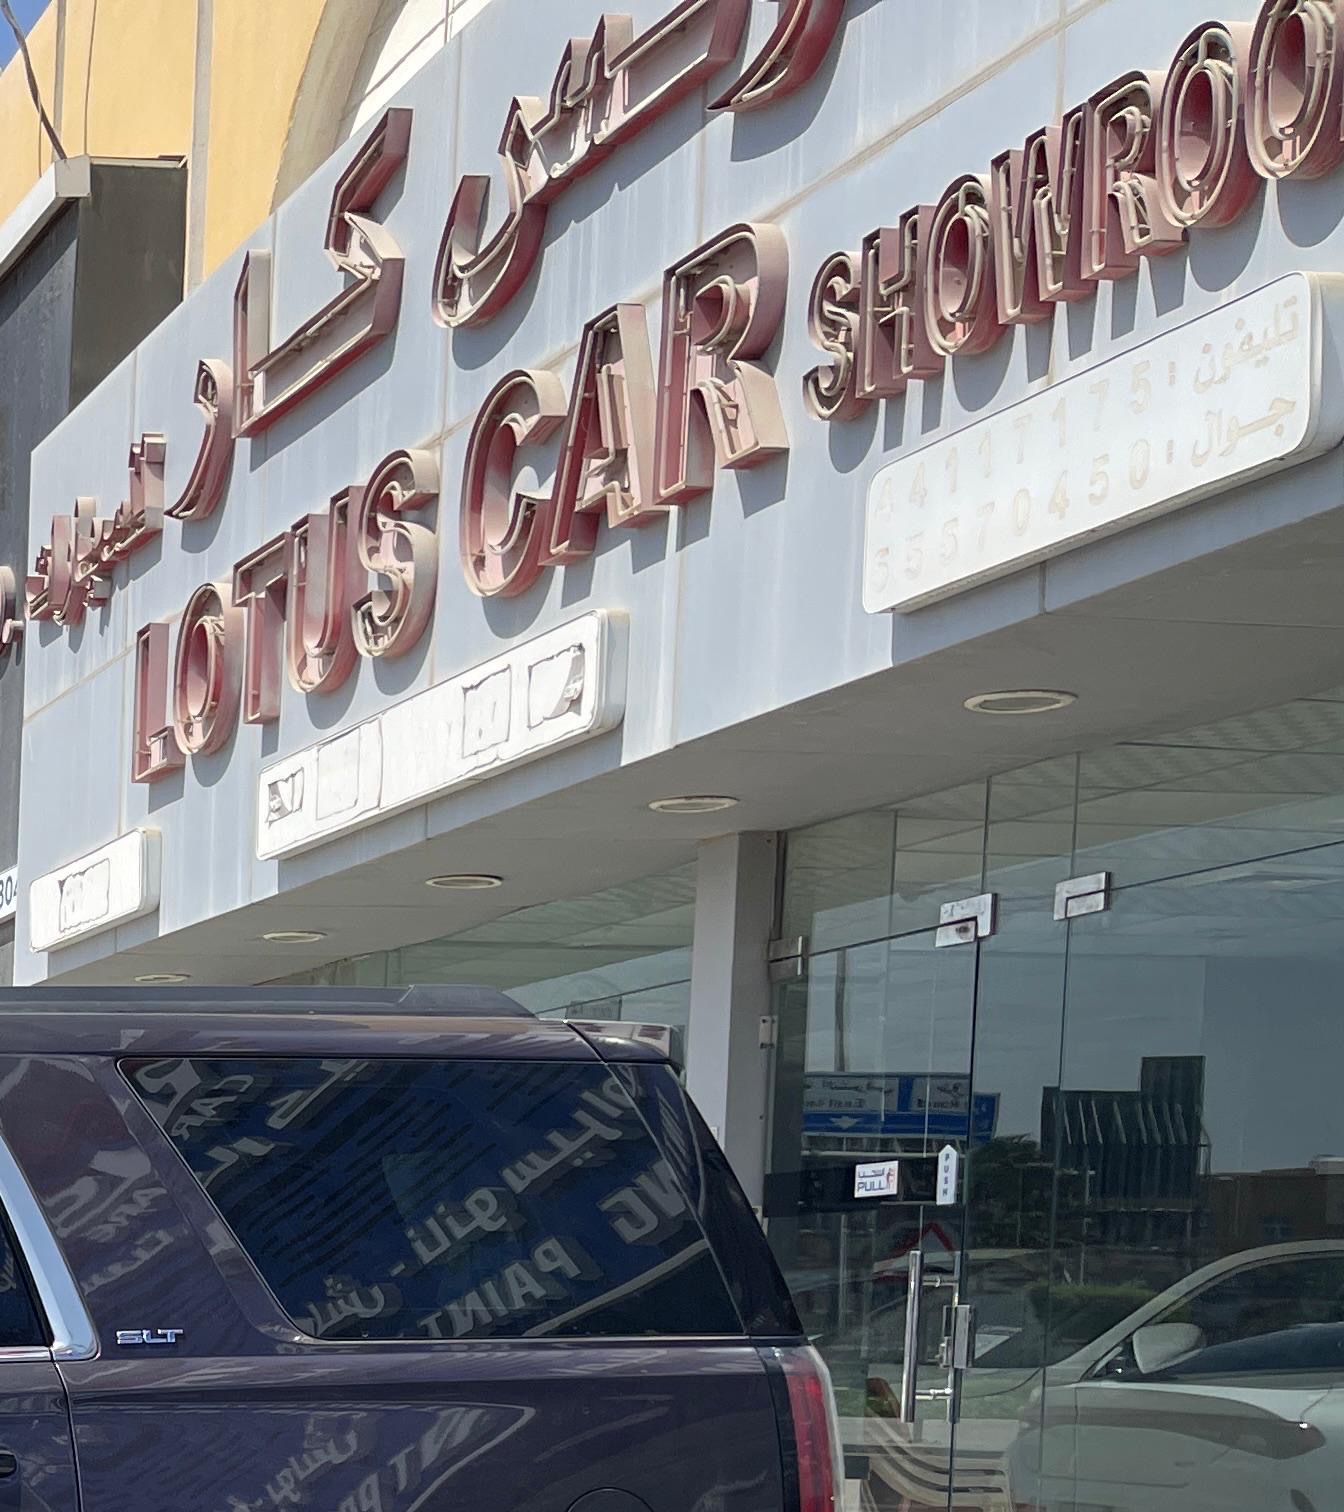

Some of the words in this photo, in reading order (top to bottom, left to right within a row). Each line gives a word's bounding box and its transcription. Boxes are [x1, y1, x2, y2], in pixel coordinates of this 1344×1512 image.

[133, 449, 438, 783] LOTUS
[459, 230, 789, 598] CAR
[802, 0, 1344, 421] SHOWROO
[857, 1180, 885, 1193] PULL
[116, 1328, 184, 1345] SLT
